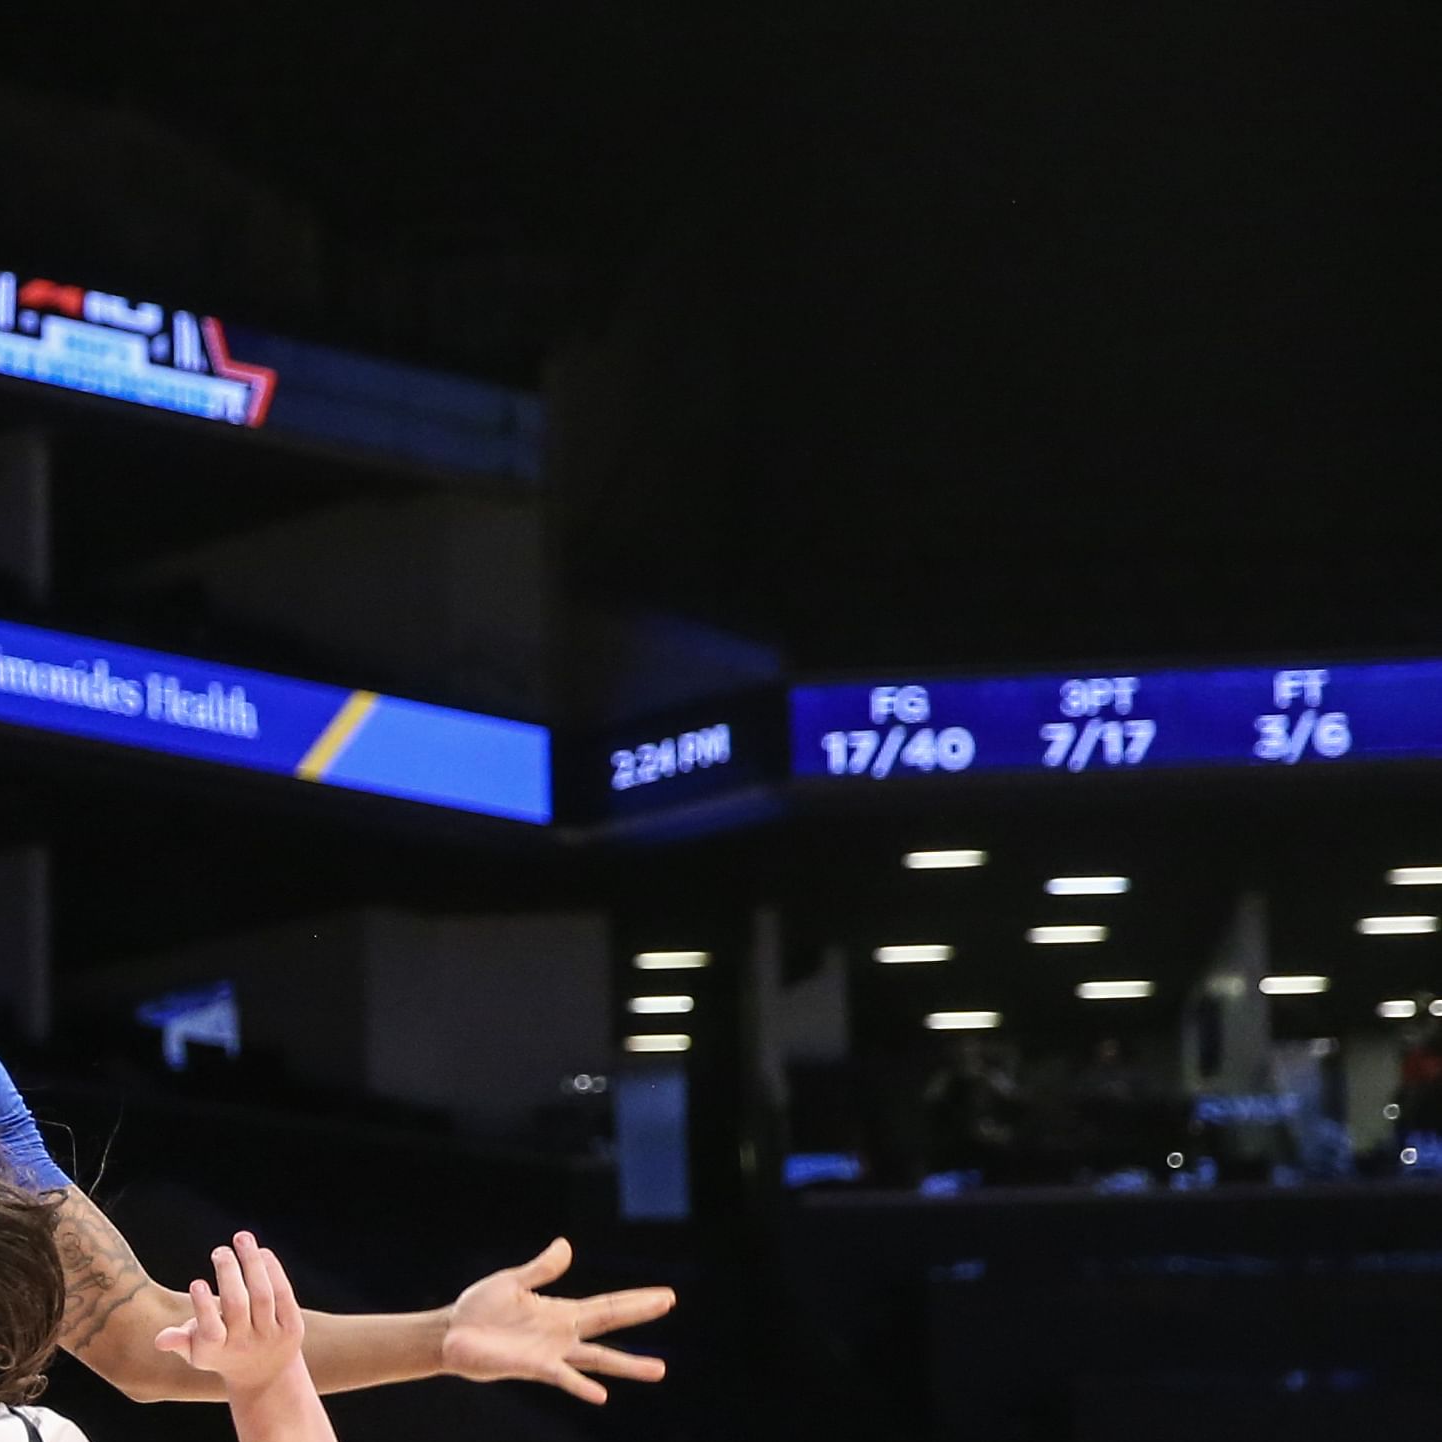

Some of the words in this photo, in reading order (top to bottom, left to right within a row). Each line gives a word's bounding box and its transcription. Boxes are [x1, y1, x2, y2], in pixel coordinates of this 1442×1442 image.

[146, 672, 260, 739] Health
[870, 685, 930, 725] FG
[1060, 677, 1140, 717] 3PT
[1273, 669, 1330, 709] FT
[821, 725, 976, 780] 17/40
[1039, 717, 1158, 773] 7/17
[1253, 709, 1352, 765] 3/6
